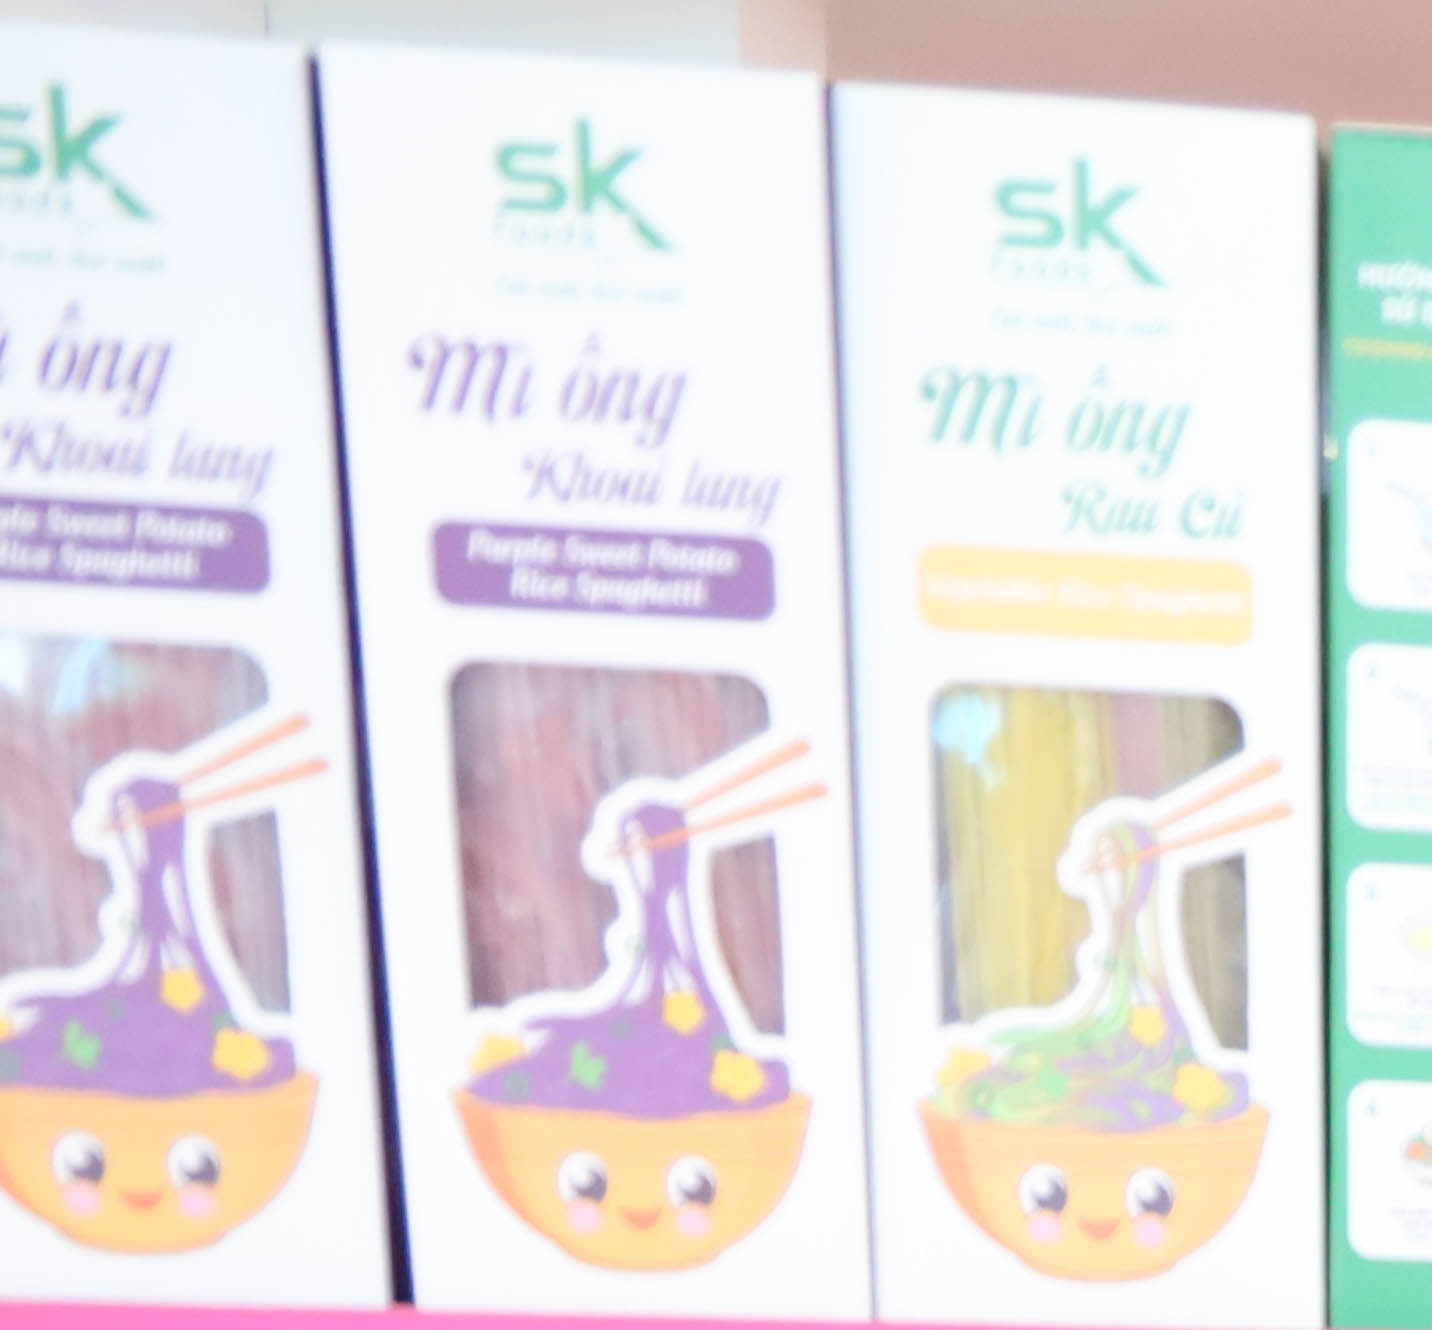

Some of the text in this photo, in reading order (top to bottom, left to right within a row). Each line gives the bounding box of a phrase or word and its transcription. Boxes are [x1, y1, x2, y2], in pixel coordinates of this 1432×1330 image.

[468, 531, 738, 573] Purple Sweet Potato
[510, 568, 707, 609] Rice Spaghetti
